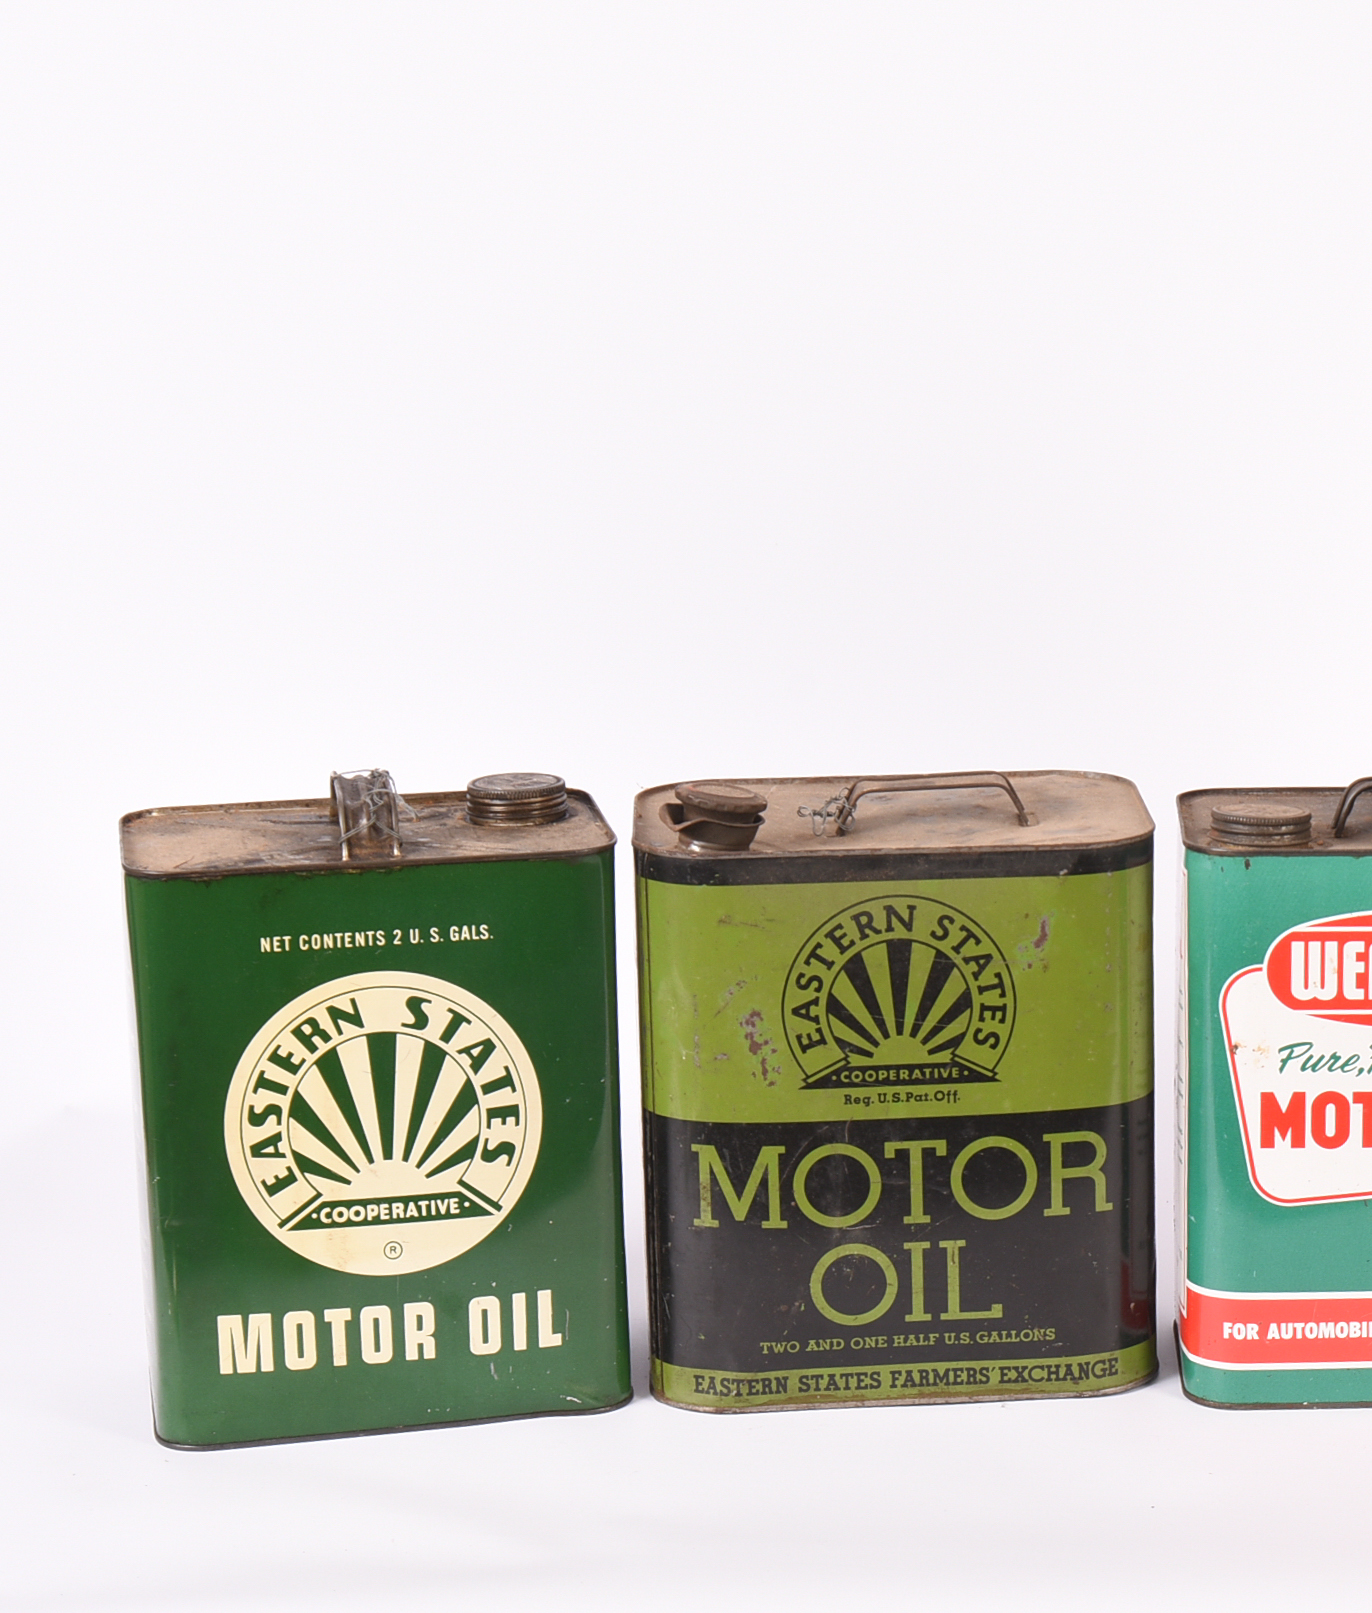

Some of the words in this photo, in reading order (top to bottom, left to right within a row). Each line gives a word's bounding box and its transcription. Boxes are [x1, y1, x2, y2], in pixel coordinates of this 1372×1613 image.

[260, 936, 291, 953] NET
[299, 930, 386, 951] CONTENTS
[392, 928, 402, 945] 2
[449, 923, 494, 942] GALS.
[790, 903, 917, 1055] EASTERN
[929, 914, 1008, 1051] STATES
[840, 1067, 960, 1083] COOPERATIVE
[1278, 1041, 1366, 1077] Pure,
[248, 996, 366, 1198] EASTERN
[400, 995, 522, 1167] STATES
[843, 1093, 875, 1107] Reg.
[690, 1131, 1114, 1230] MOTOR
[319, 1197, 460, 1224] COOPERATIVE
[809, 1239, 1003, 1327] OIL
[217, 1301, 437, 1375] MOTOR
[468, 1289, 563, 1356] OIL
[760, 1340, 800, 1354] TWO
[805, 1337, 845, 1352] AND
[850, 1335, 888, 1350] ONE
[892, 1333, 939, 1347] HALF
[976, 1328, 1056, 1344] GALLONS
[1222, 1319, 1260, 1341] FOR
[693, 1374, 789, 1397] EASTERN
[797, 1370, 882, 1393] STATES
[998, 1357, 1120, 1385] EXCHANGE
